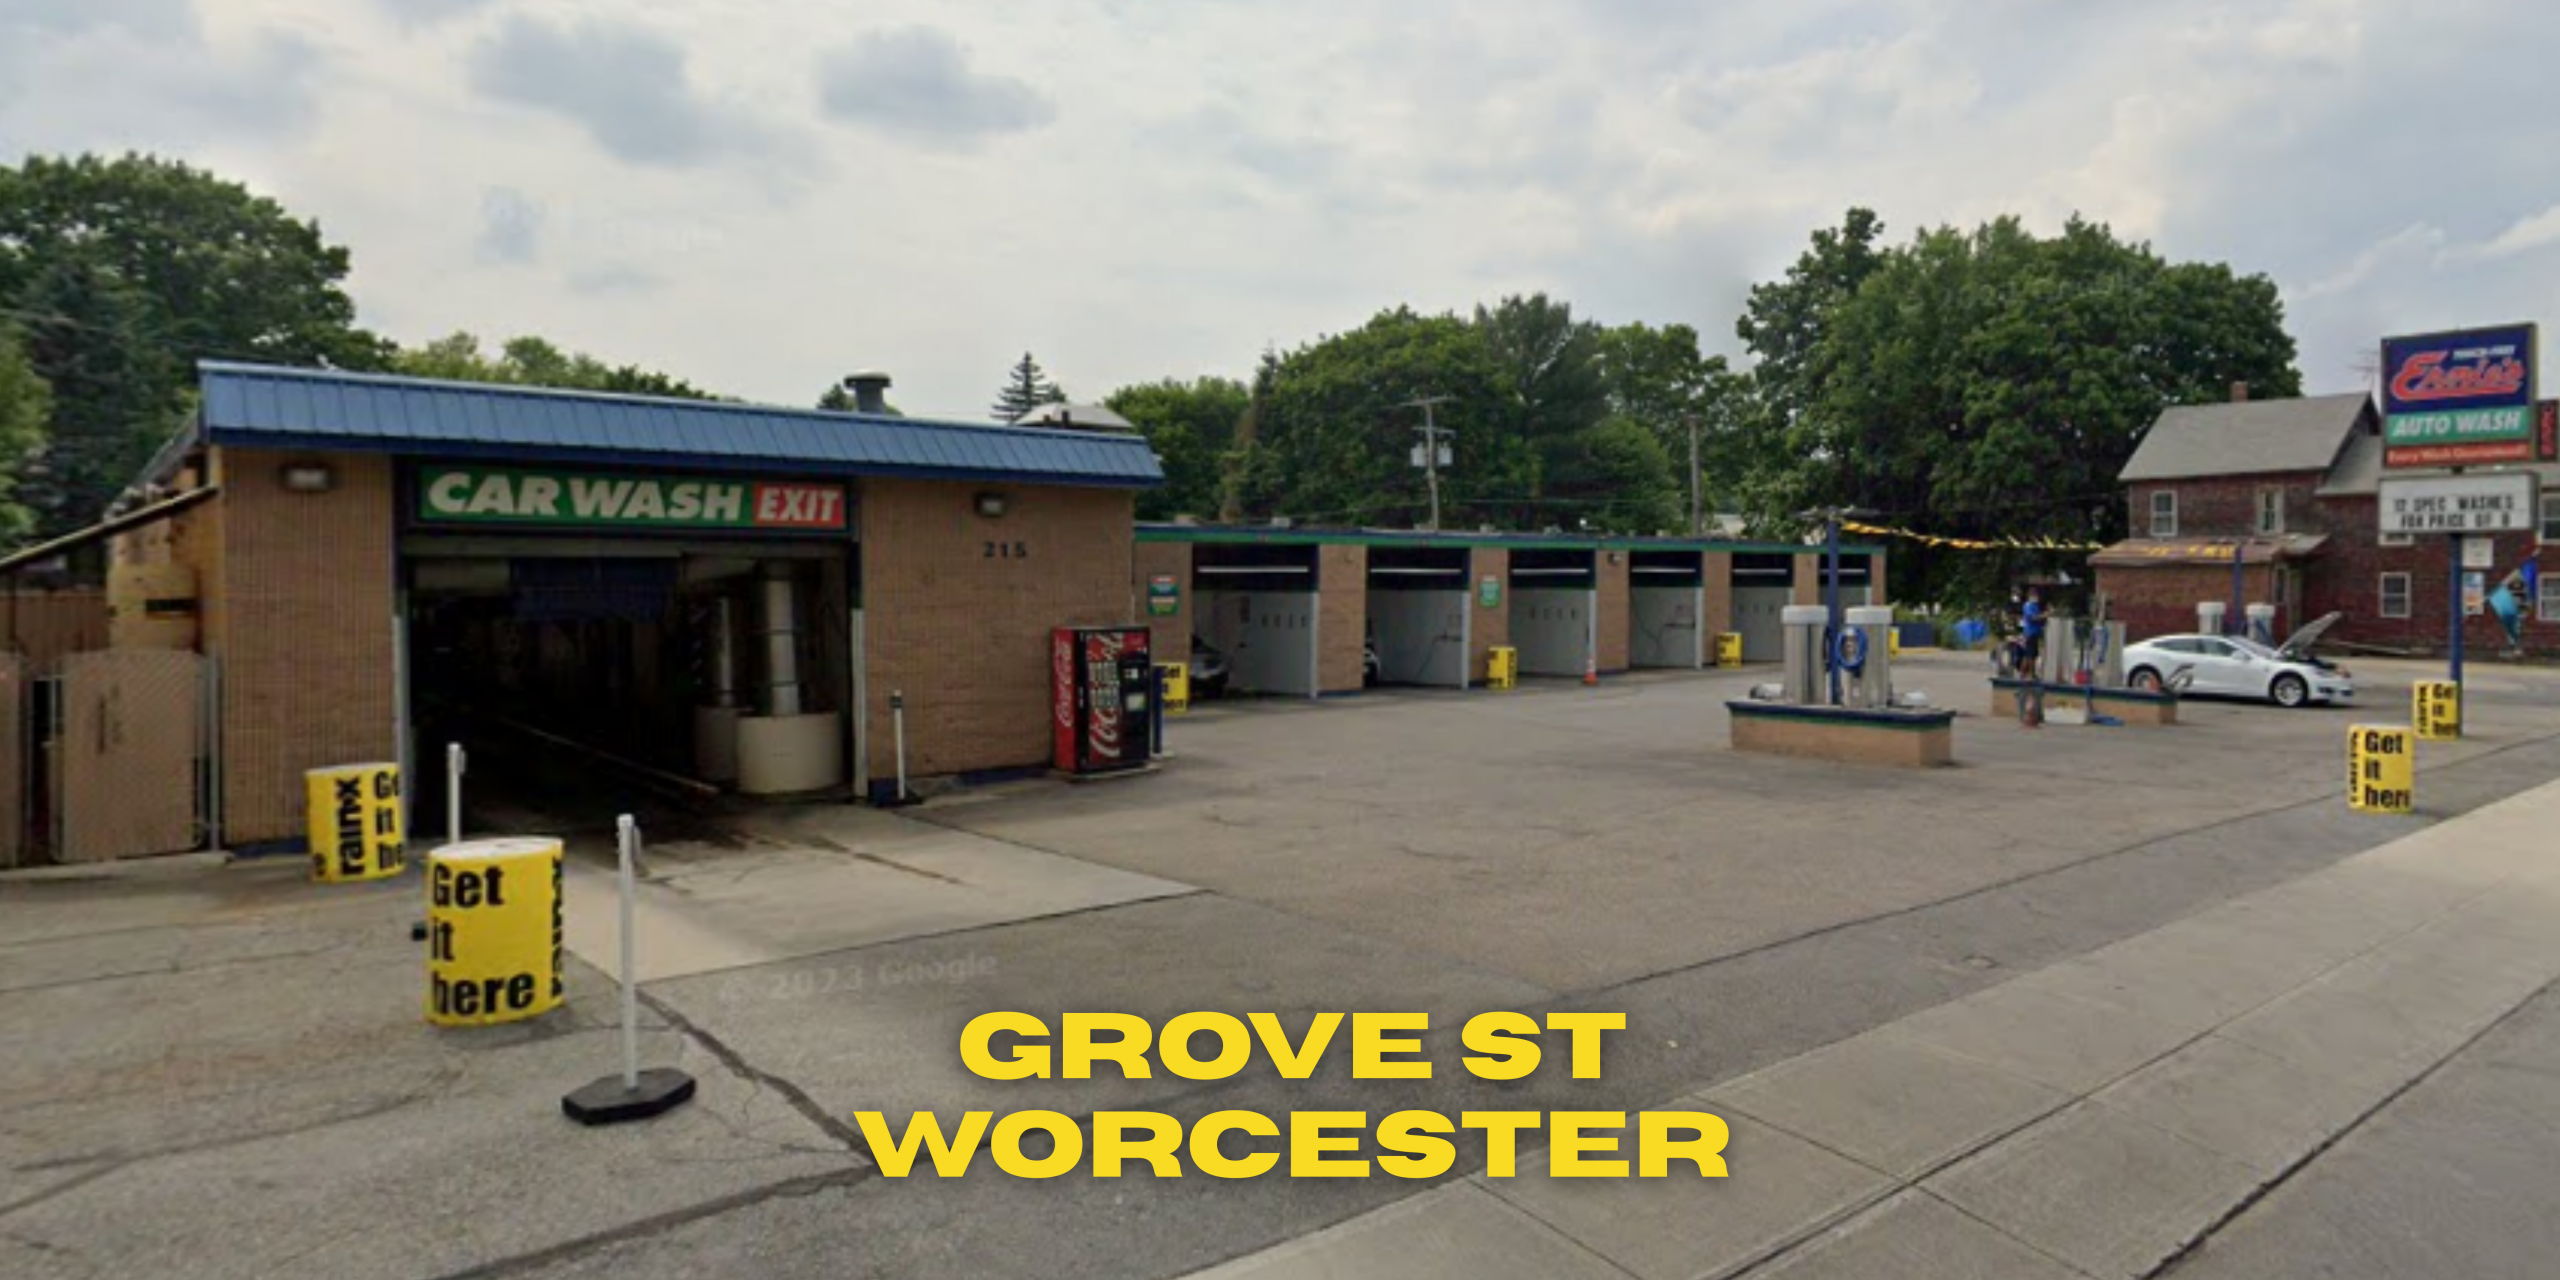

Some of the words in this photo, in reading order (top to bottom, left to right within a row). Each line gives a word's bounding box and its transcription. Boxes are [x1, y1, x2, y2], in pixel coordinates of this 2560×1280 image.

[2393, 416, 2450, 438] AUTO
[2456, 411, 2522, 434] WASH
[428, 472, 558, 516] CAR
[568, 478, 744, 521] WASH
[757, 488, 840, 522] EXIT
[2413, 497, 2446, 512] SPEC
[2457, 495, 2514, 510] WASHES
[2401, 514, 2423, 528] FOR
[2429, 513, 2465, 528] PRICE
[983, 541, 1027, 558] 215
[2365, 730, 2403, 755] Get
[2365, 758, 2381, 781] it
[375, 807, 394, 836] it
[432, 862, 504, 909] Get
[431, 916, 455, 963] it
[431, 969, 535, 1016] here
